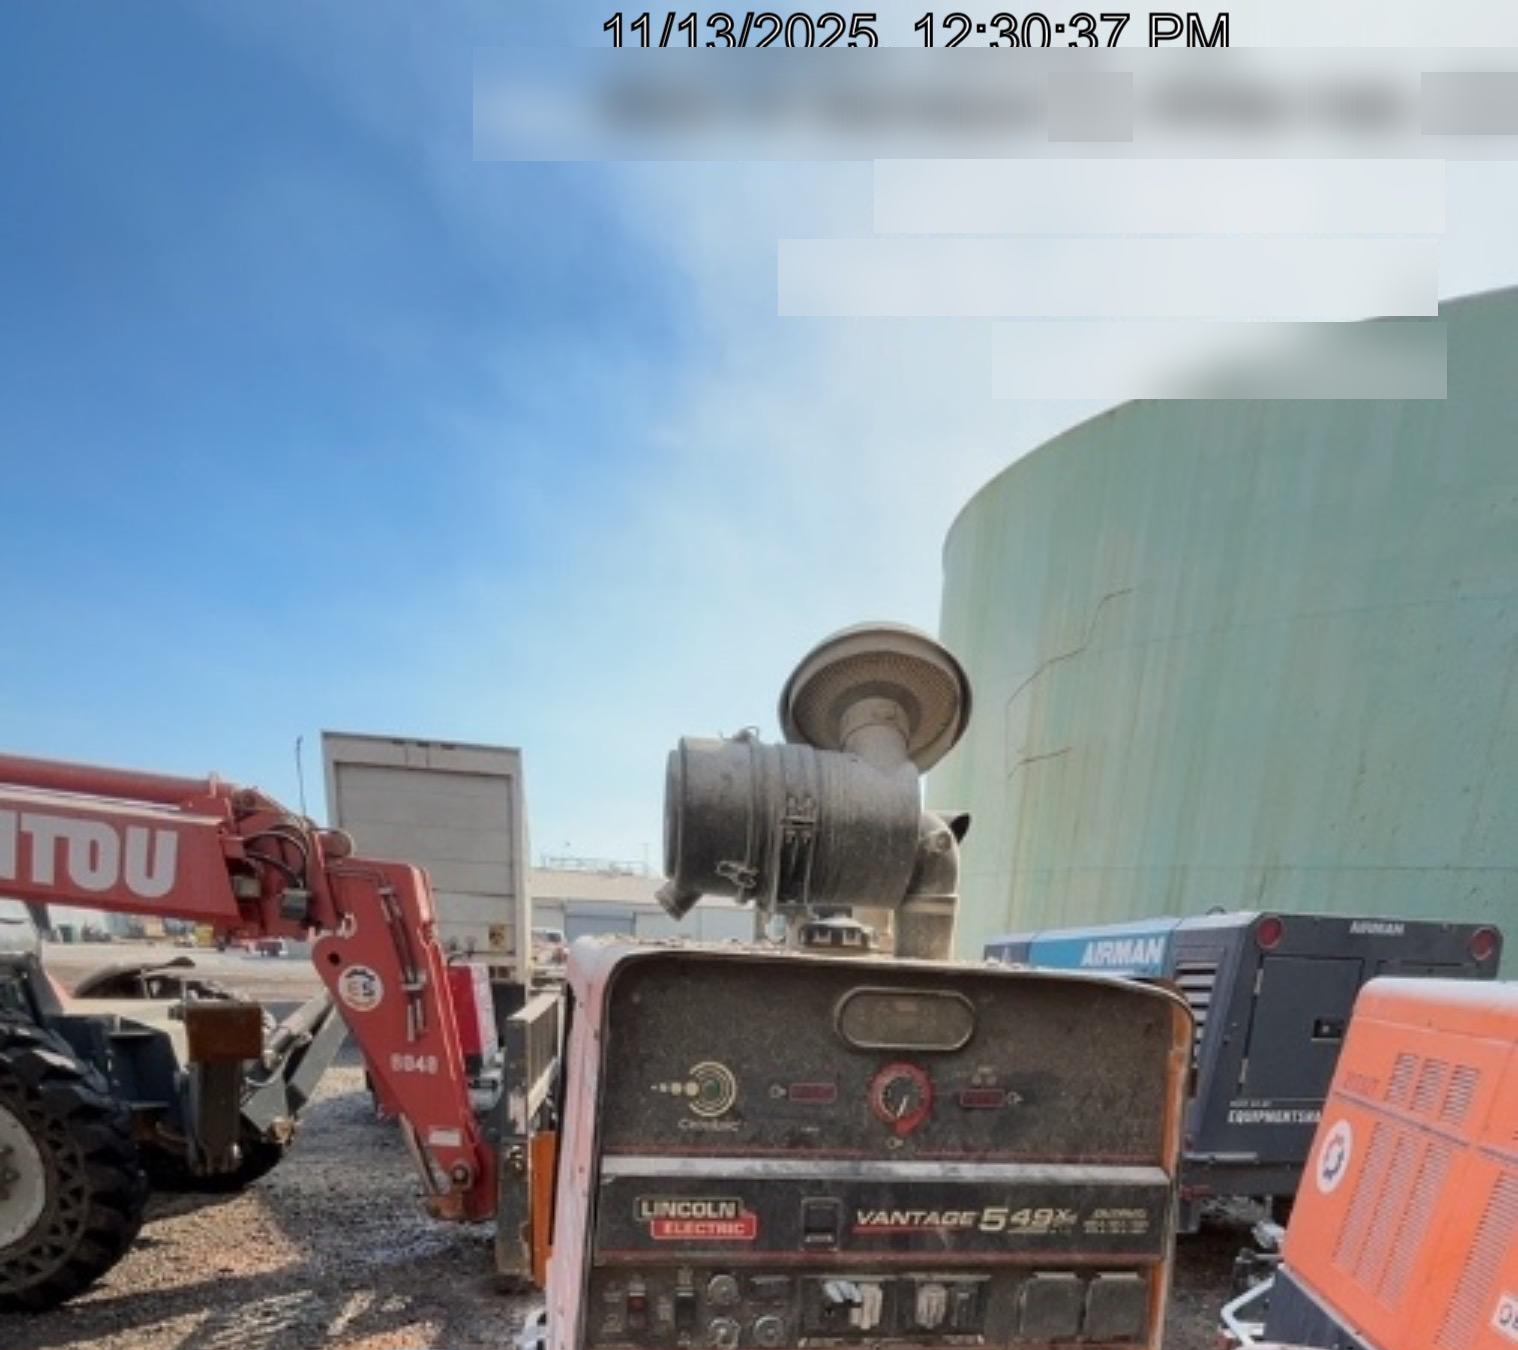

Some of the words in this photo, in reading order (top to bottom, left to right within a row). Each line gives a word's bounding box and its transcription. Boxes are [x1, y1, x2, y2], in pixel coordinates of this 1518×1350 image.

[1081, 936, 1166, 967] AIRMAN
[641, 1201, 737, 1219] LINCOLN
[857, 1209, 978, 1226] VANTAGE
[663, 1220, 747, 1235] ELECTRIC
